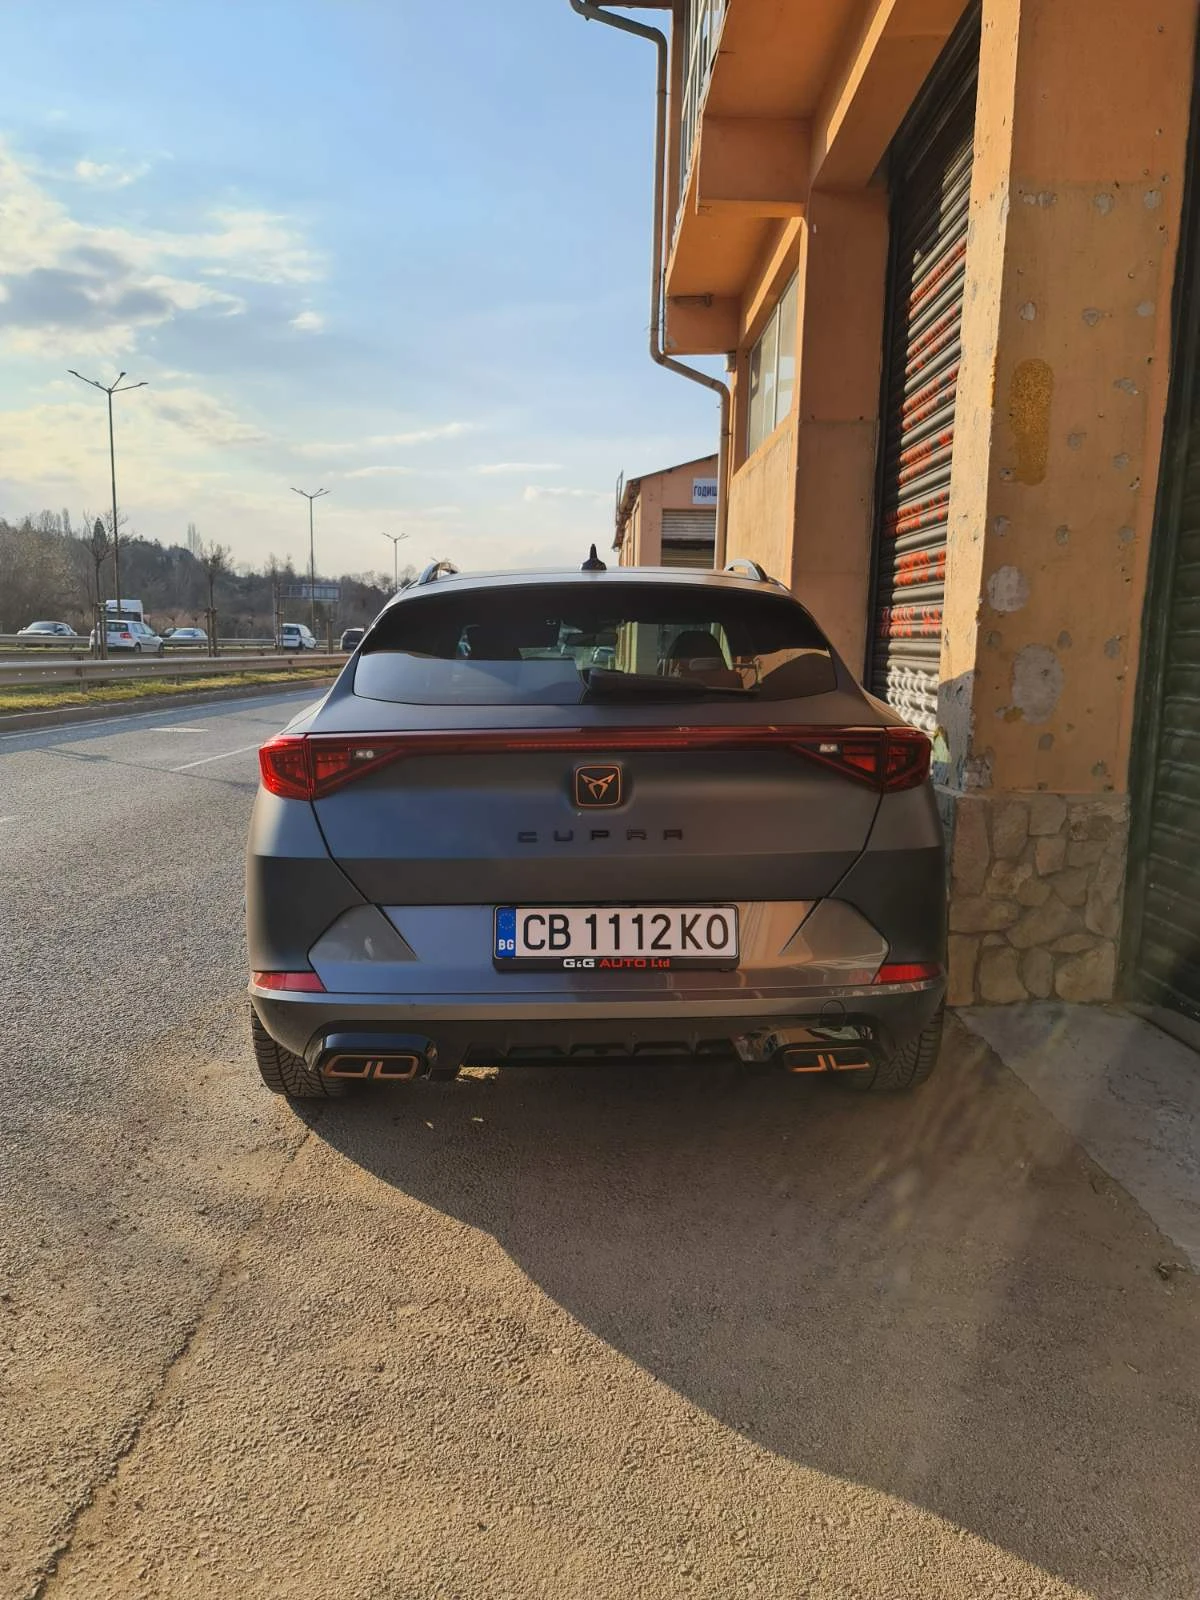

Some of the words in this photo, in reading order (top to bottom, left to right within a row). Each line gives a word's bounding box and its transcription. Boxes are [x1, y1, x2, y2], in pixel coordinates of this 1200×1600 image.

[517, 829, 683, 843] CUPRA
[523, 914, 571, 950] CB
[585, 913, 672, 950] 1112
[681, 914, 729, 950] KO
[498, 939, 514, 950] BG
[600, 958, 646, 968] AUTO
[651, 959, 670, 968] Ltd
